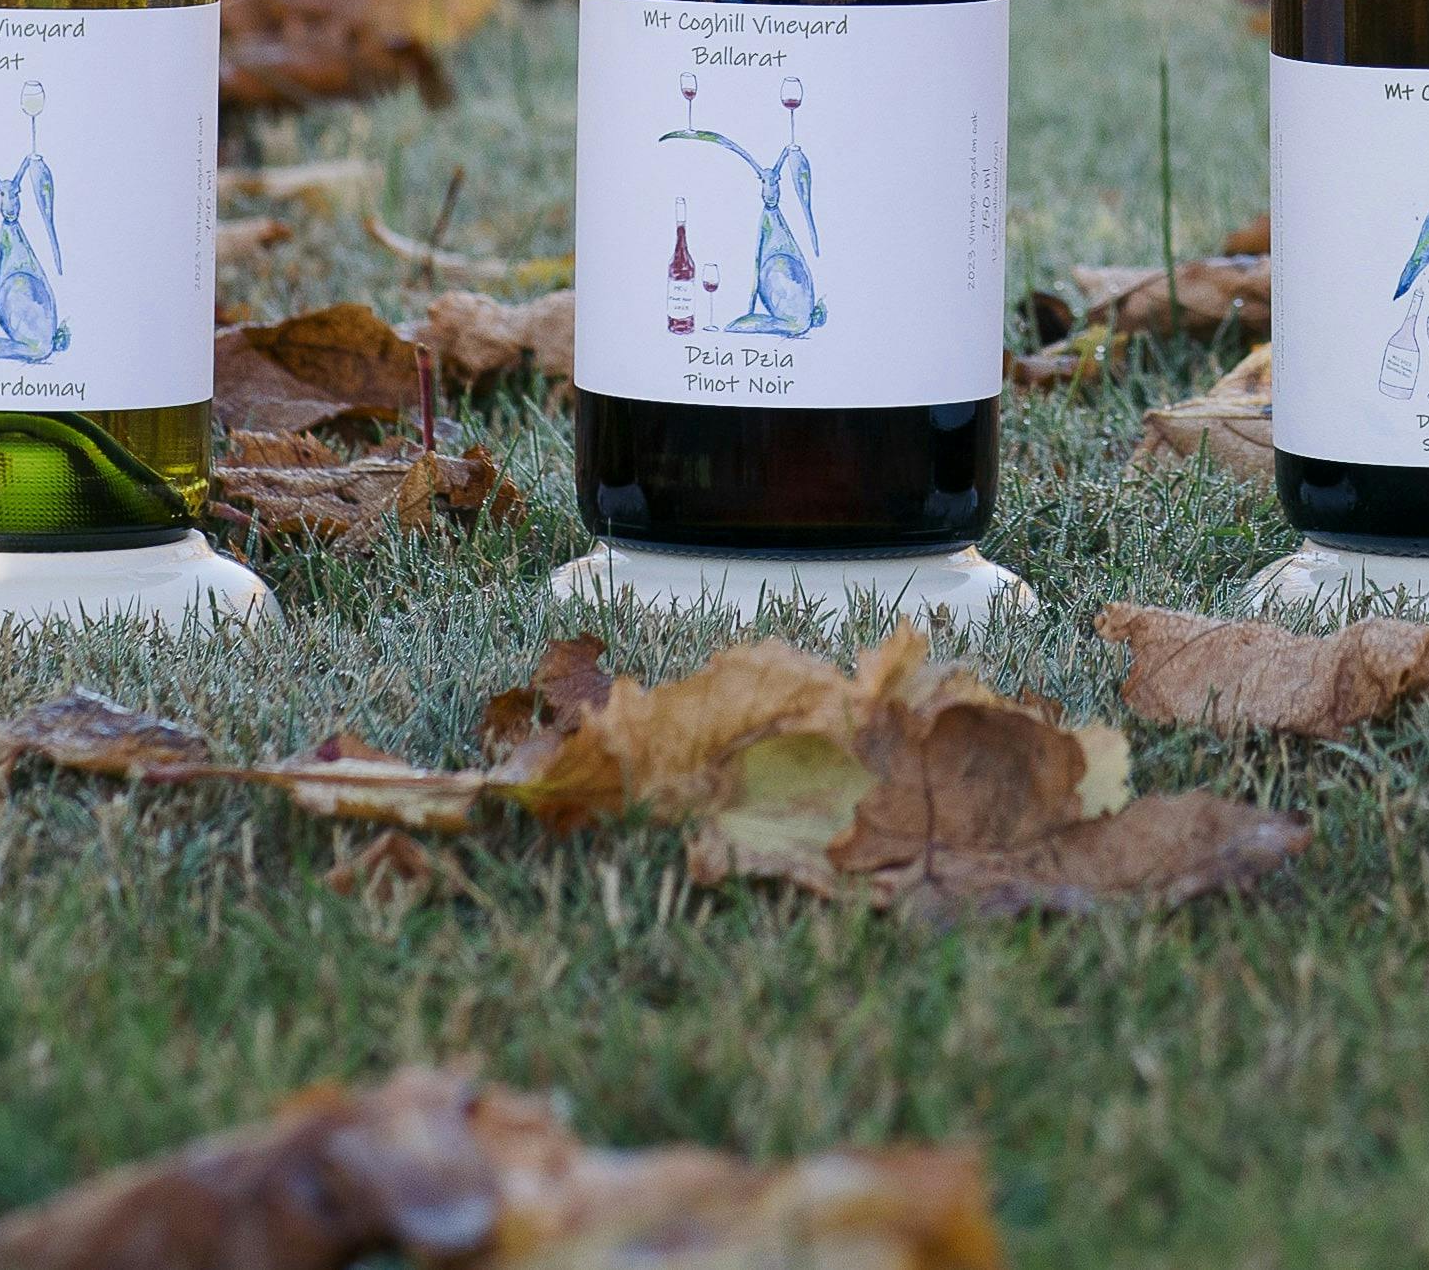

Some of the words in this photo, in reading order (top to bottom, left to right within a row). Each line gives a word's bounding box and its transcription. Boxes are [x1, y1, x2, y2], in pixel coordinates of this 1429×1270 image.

[643, 9, 672, 29] Mt
[678, 12, 745, 39] Coghill
[751, 13, 848, 40] Vineyard
[691, 45, 788, 68] Ballarat
[1384, 82, 1415, 101] Mt
[968, 156, 979, 190] aged
[981, 168, 991, 190] ml
[967, 193, 979, 245] Vintage
[981, 195, 991, 236] 750
[684, 345, 734, 366] Dzia
[740, 348, 794, 368] Dzia
[682, 372, 740, 393] Pinot
[748, 375, 795, 395] Noir
